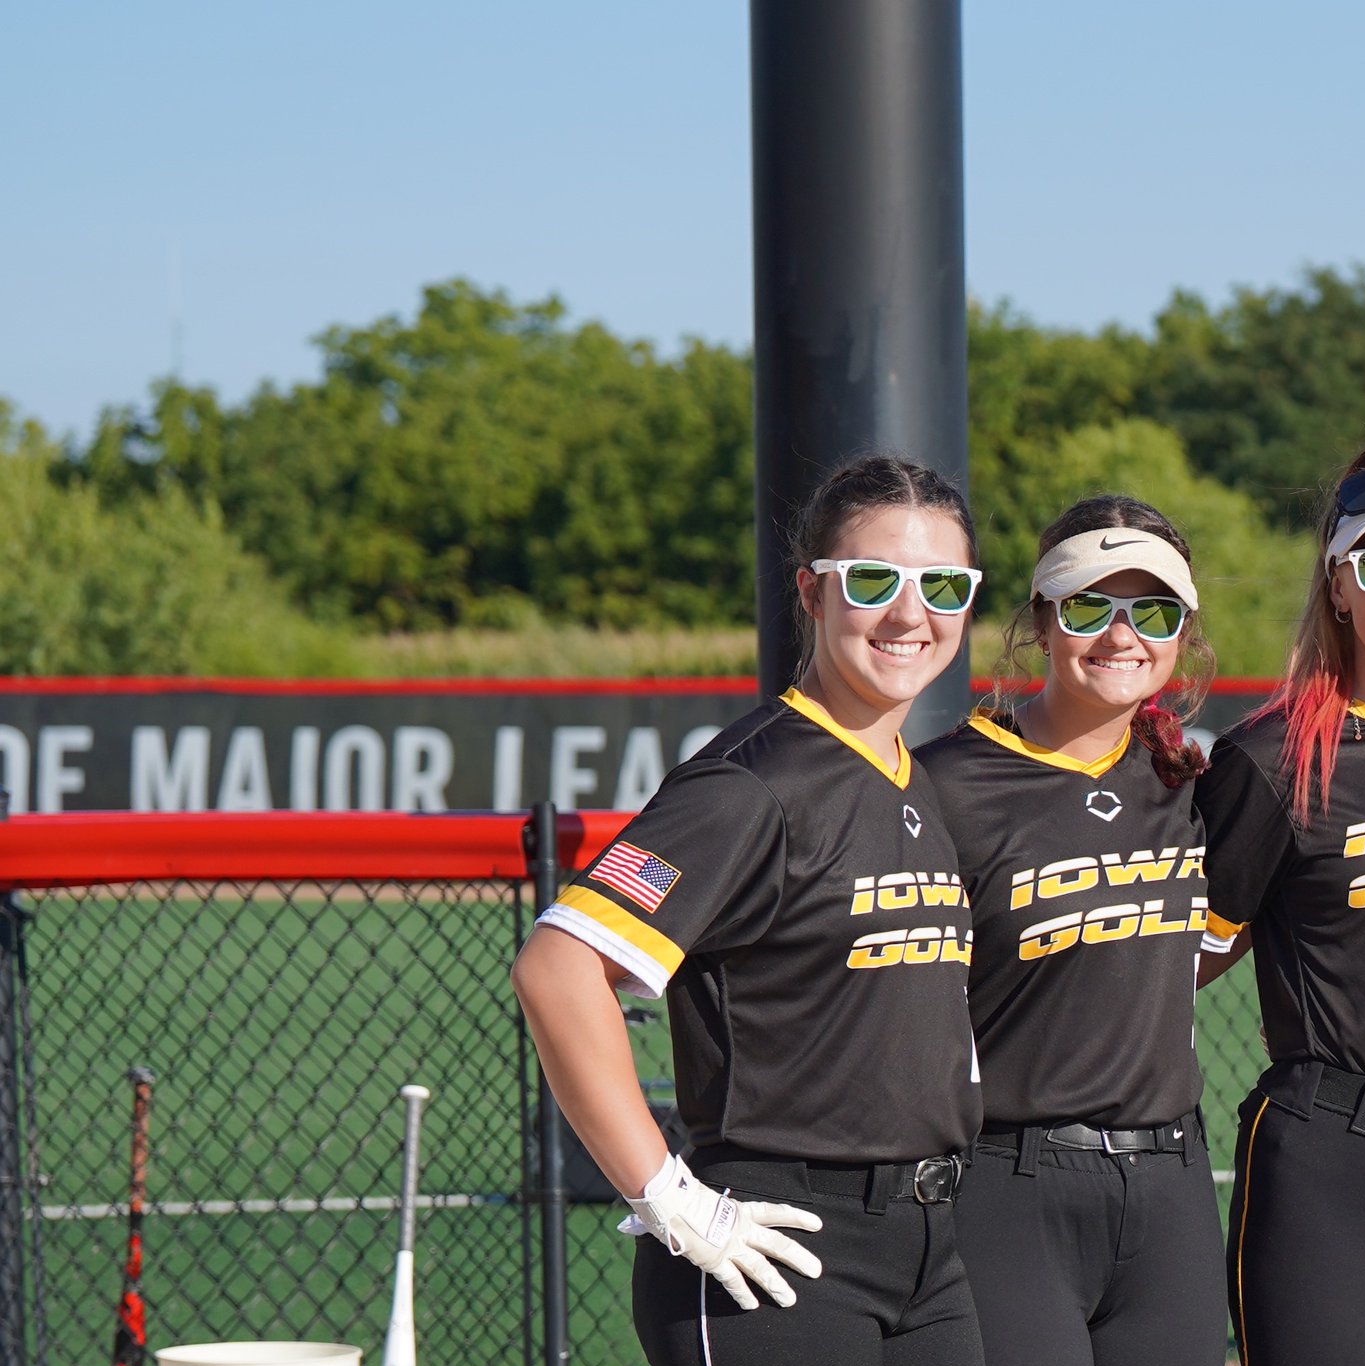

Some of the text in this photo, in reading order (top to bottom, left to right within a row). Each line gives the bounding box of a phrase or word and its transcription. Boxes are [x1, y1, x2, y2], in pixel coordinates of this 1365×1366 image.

[131, 725, 454, 813] MAJOR
[494, 725, 724, 812] LEA
[850, 871, 970, 916] IOW
[846, 925, 974, 969] GOL
